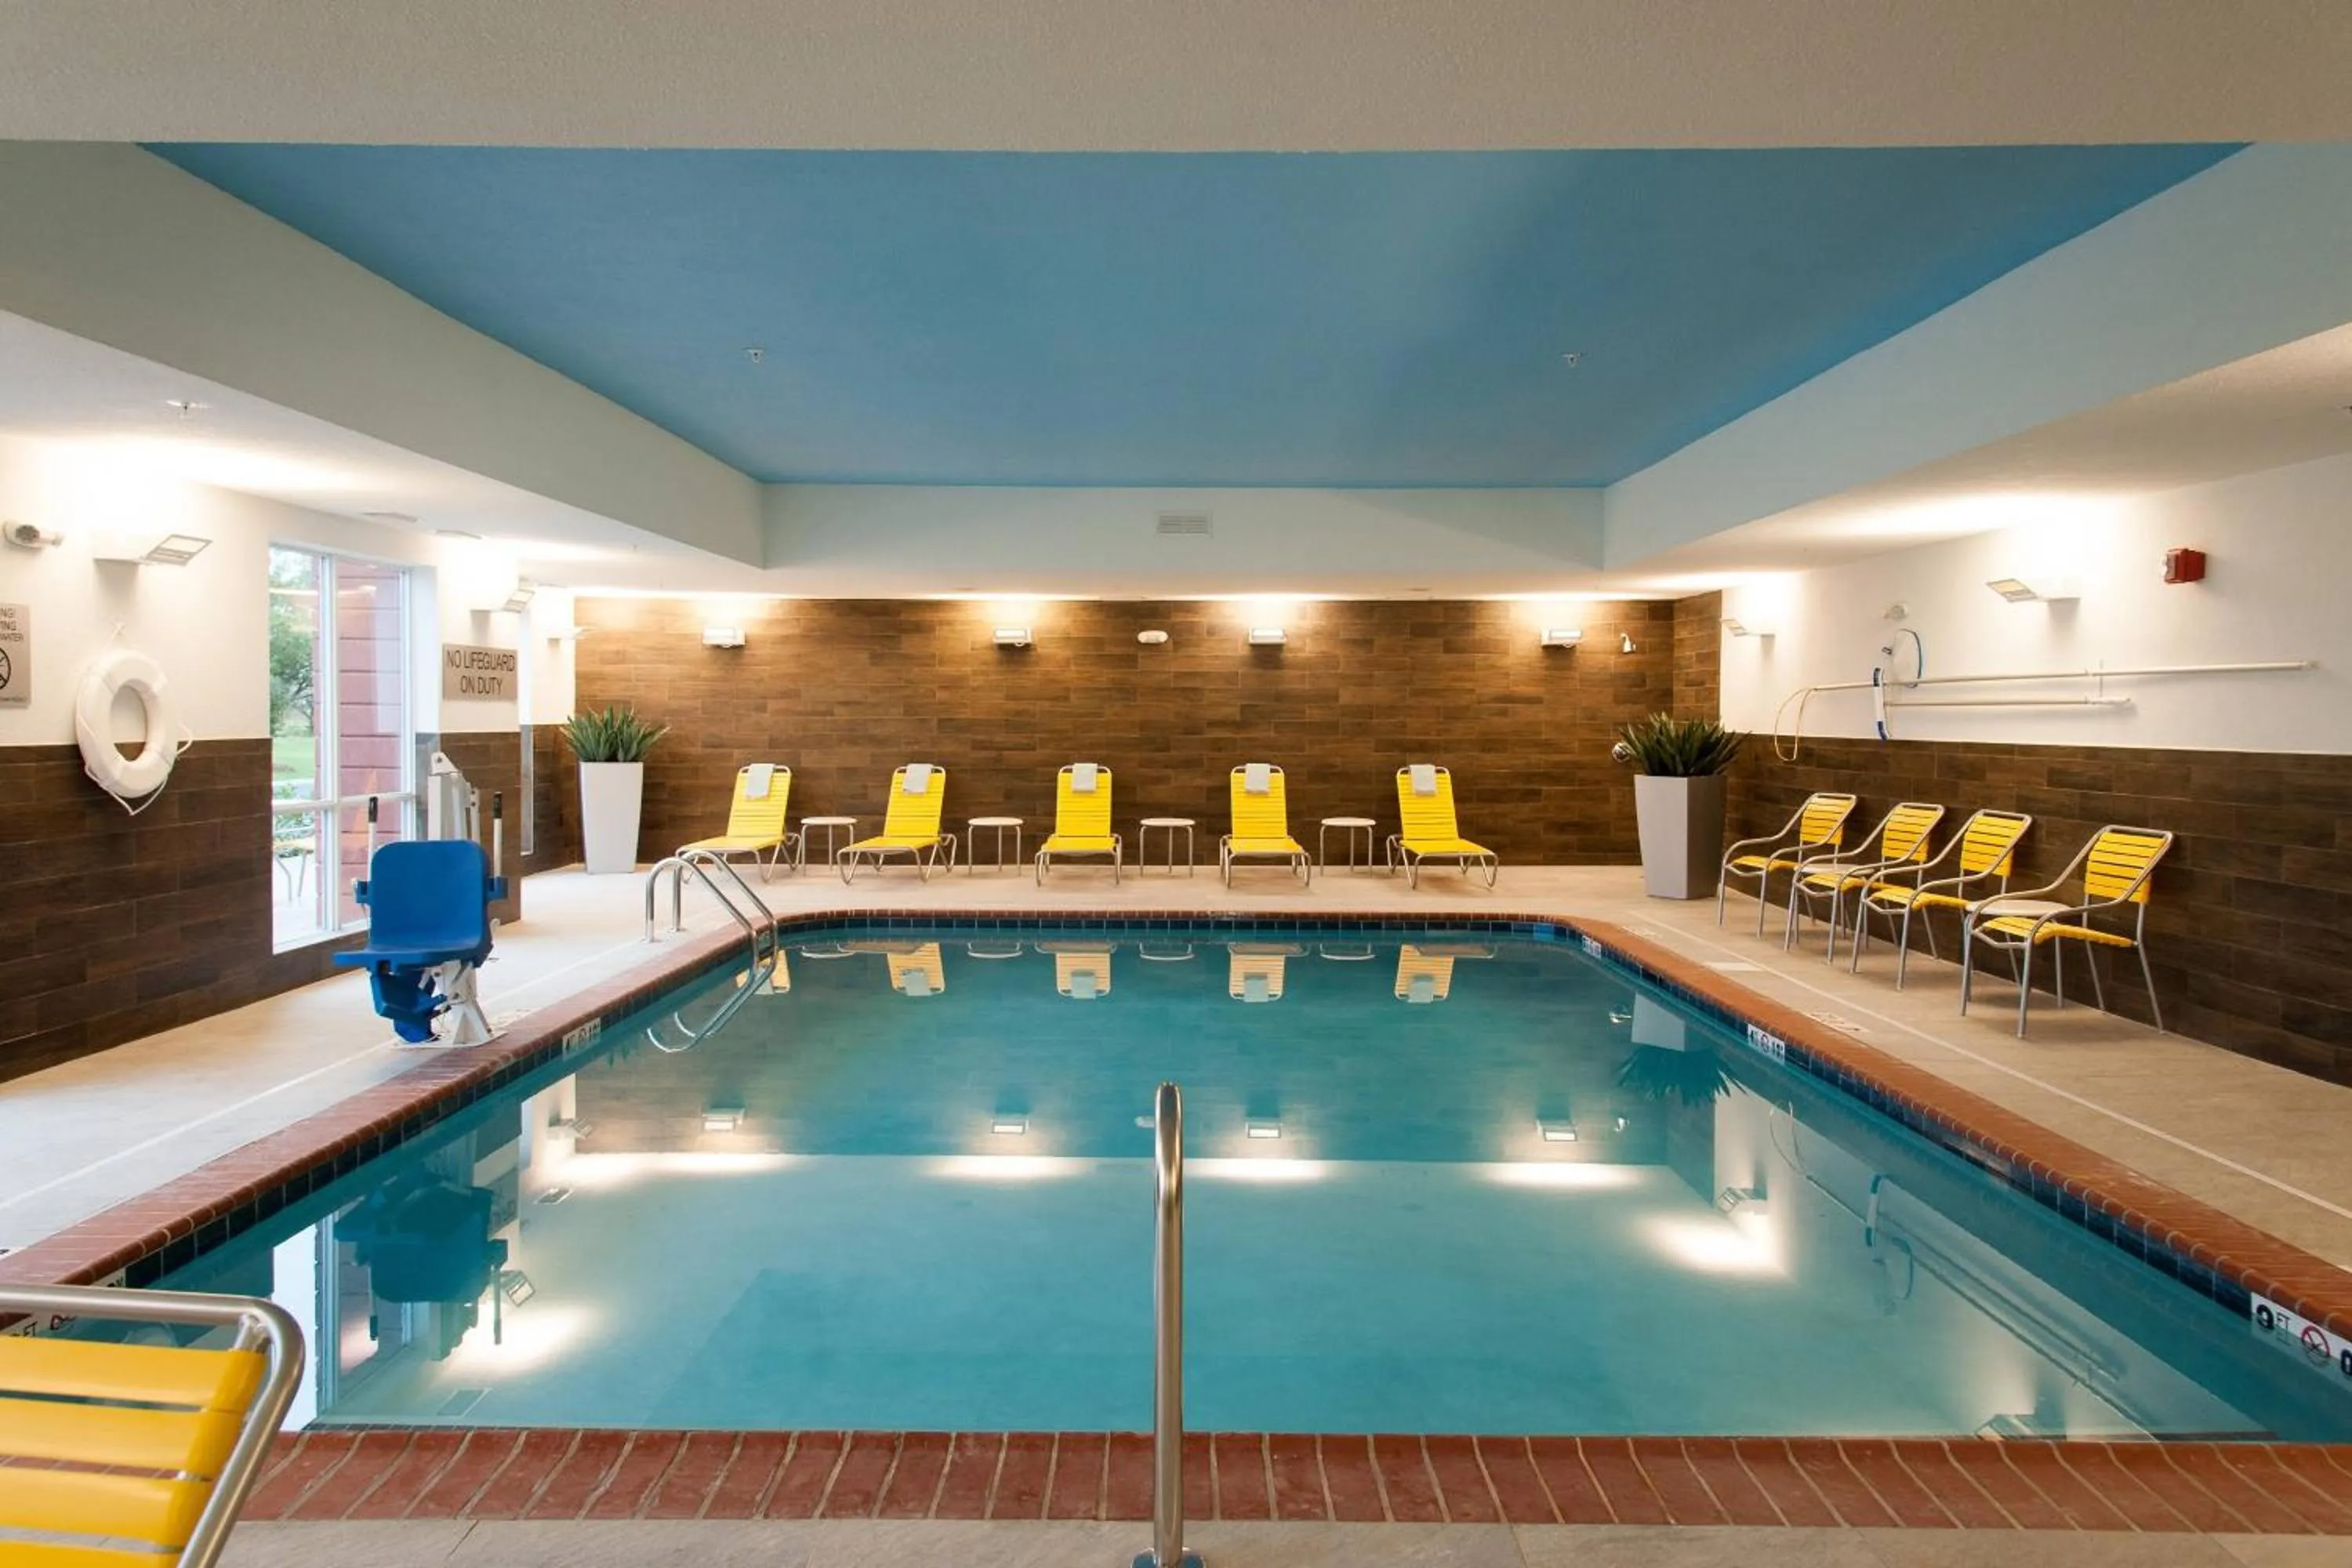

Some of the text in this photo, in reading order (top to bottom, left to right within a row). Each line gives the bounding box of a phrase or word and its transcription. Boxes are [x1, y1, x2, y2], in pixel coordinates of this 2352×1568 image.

[447, 649, 515, 671] NO LIFEGUARD
[461, 675, 503, 695] ON DUTY
